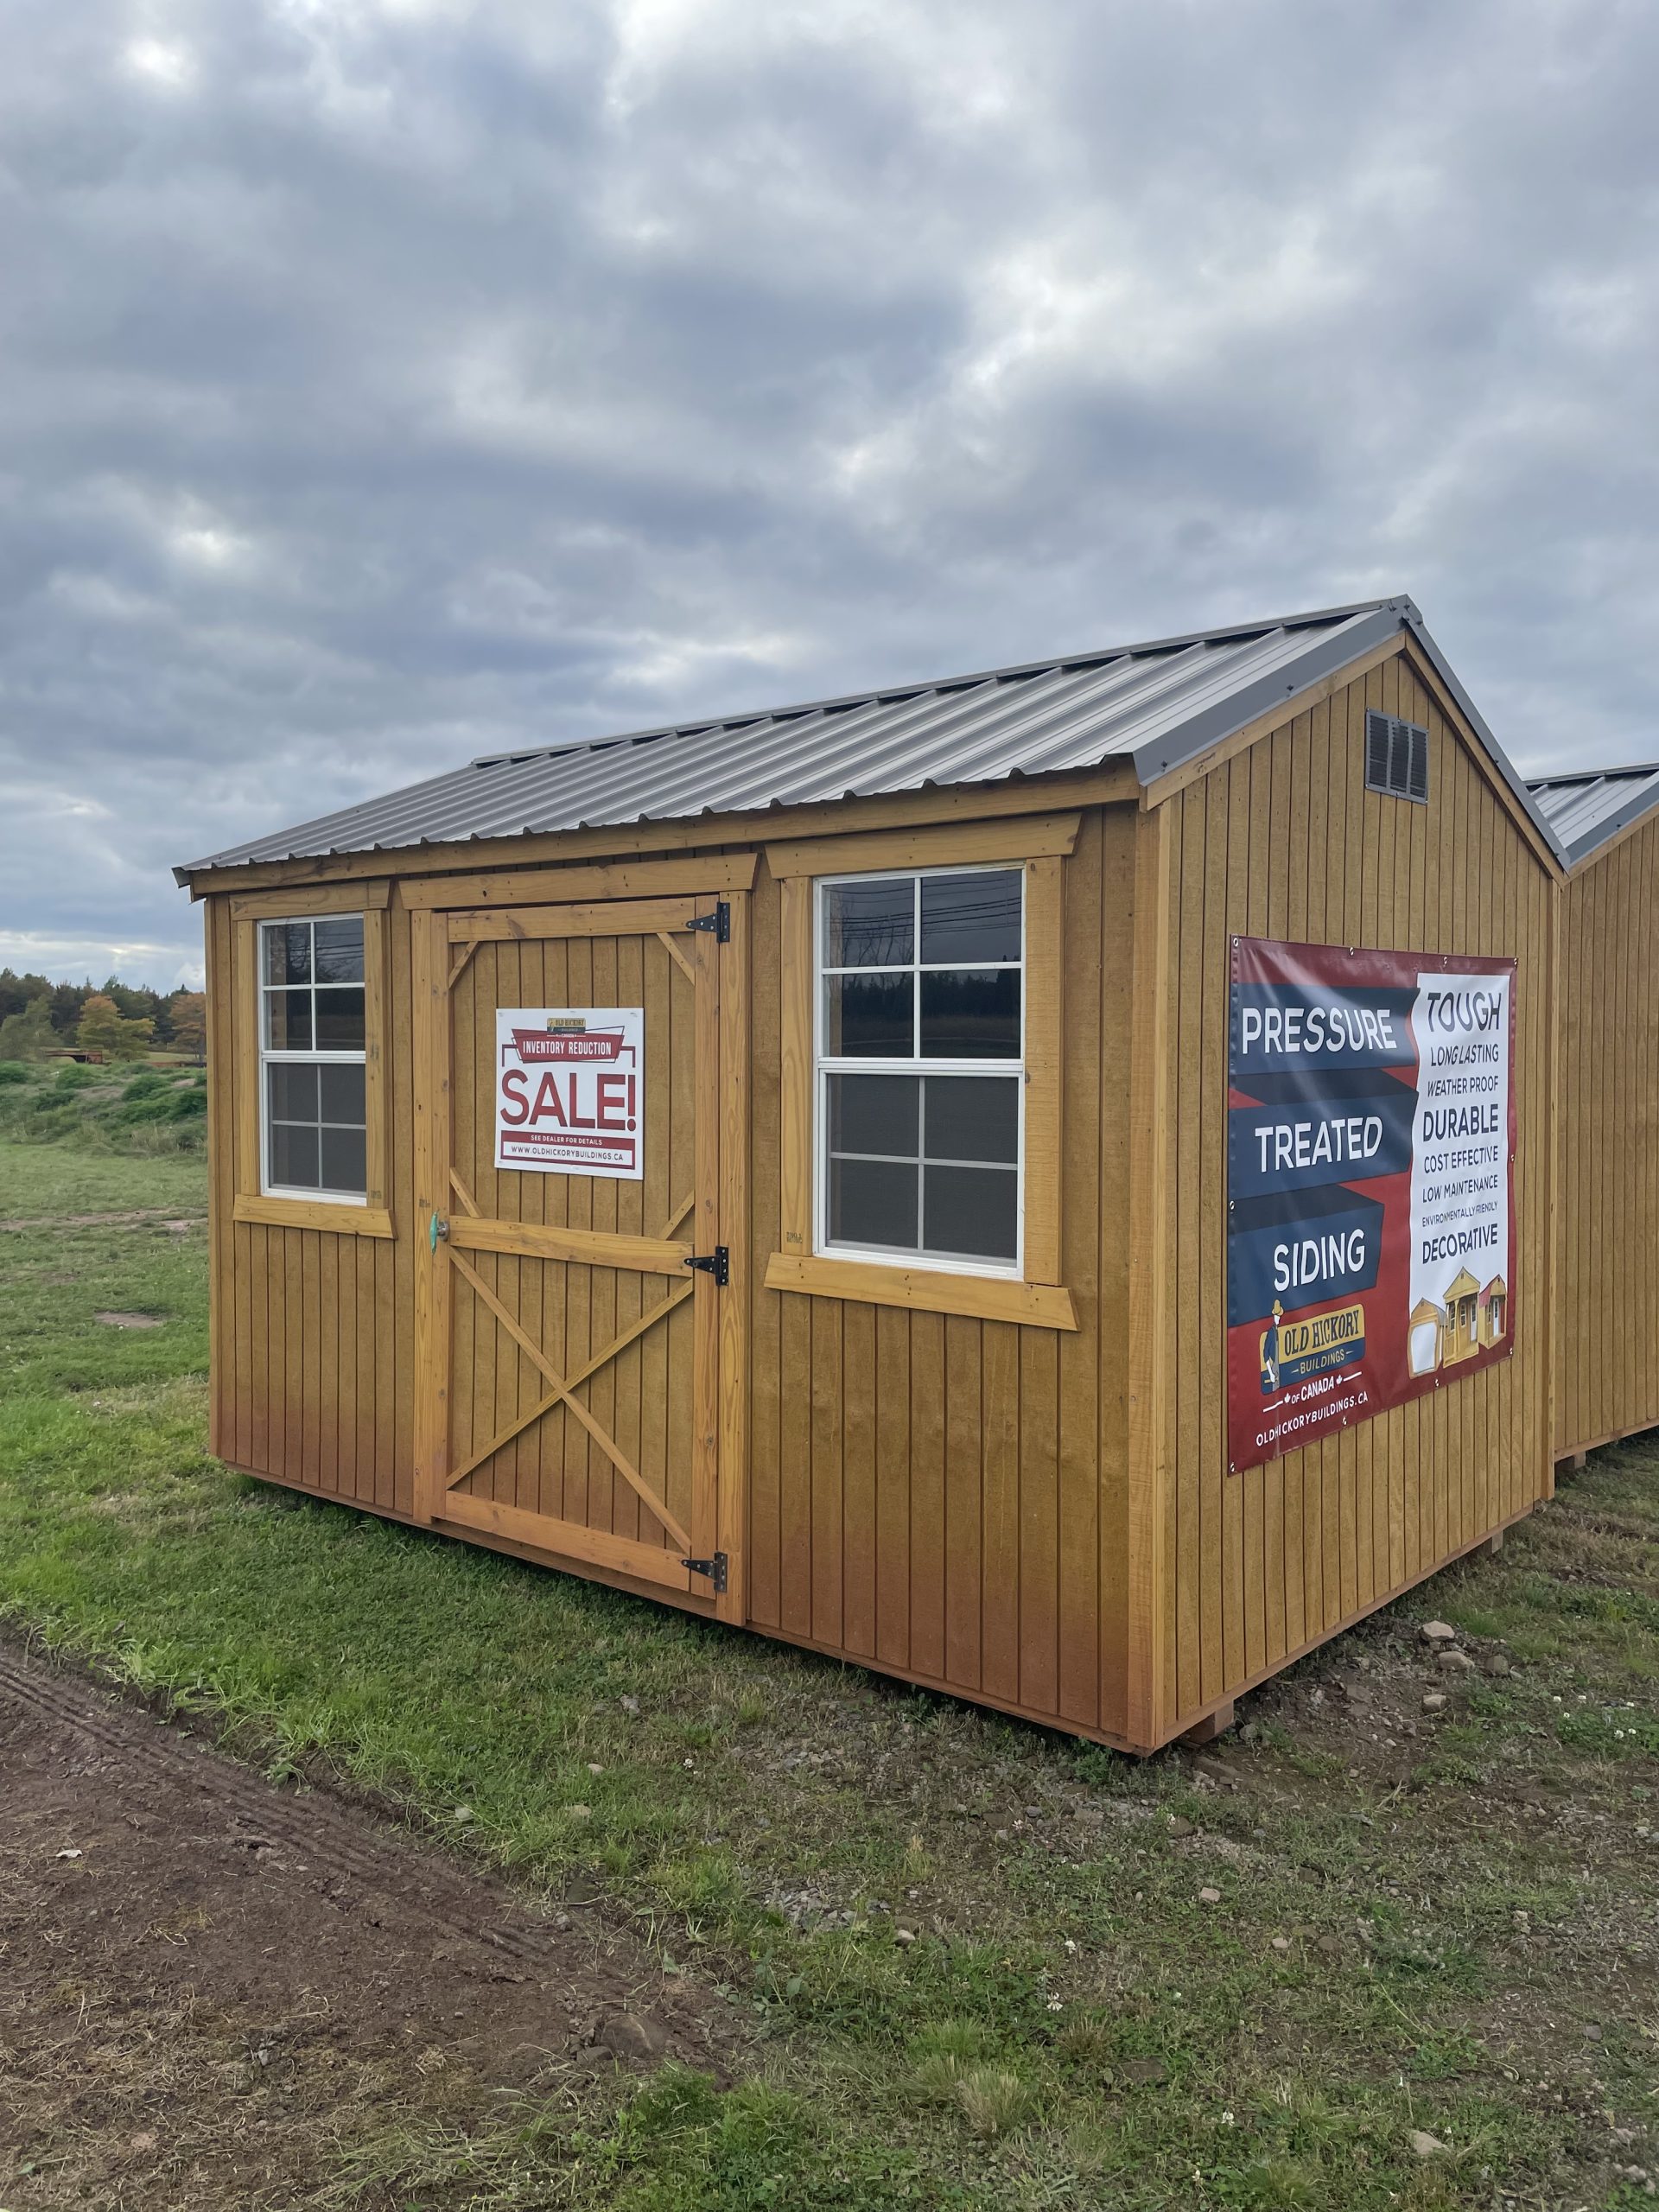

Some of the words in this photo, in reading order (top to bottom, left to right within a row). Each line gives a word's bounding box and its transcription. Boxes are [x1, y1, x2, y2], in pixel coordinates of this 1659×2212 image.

[1242, 1007, 1397, 1054] PRESSURE
[1427, 991, 1502, 1033] TOUGH
[523, 1040, 566, 1054] INVENTORY
[568, 1041, 612, 1055] REDUCTION
[500, 1069, 637, 1131] SALE!
[1427, 1077, 1467, 1097] WEATHER
[1470, 1076, 1499, 1093] PROOF
[1423, 1103, 1498, 1142] DURABLE
[511, 1146, 624, 1161] WWW.OLDHICKORYBUILDINGS.CA
[1255, 1116, 1382, 1173] TREATED
[1424, 1153, 1449, 1173] COST
[1452, 1145, 1498, 1169] EFFECTIVE
[1422, 1185, 1442, 1203] LOW
[1443, 1174, 1498, 1199] MAINTENANCE
[1274, 1228, 1365, 1292] SIDING
[1422, 1224, 1498, 1264] DECORATIVE
[1284, 1325, 1309, 1357] OLD
[1312, 1309, 1359, 1349] HICKORY
[1300, 1349, 1345, 1374] BUILDINGS
[1291, 1393, 1300, 1404] OF
[1300, 1376, 1334, 1401] CANADA
[1255, 1391, 1369, 1446] OLDHICKORYBUILDINGS.CA
